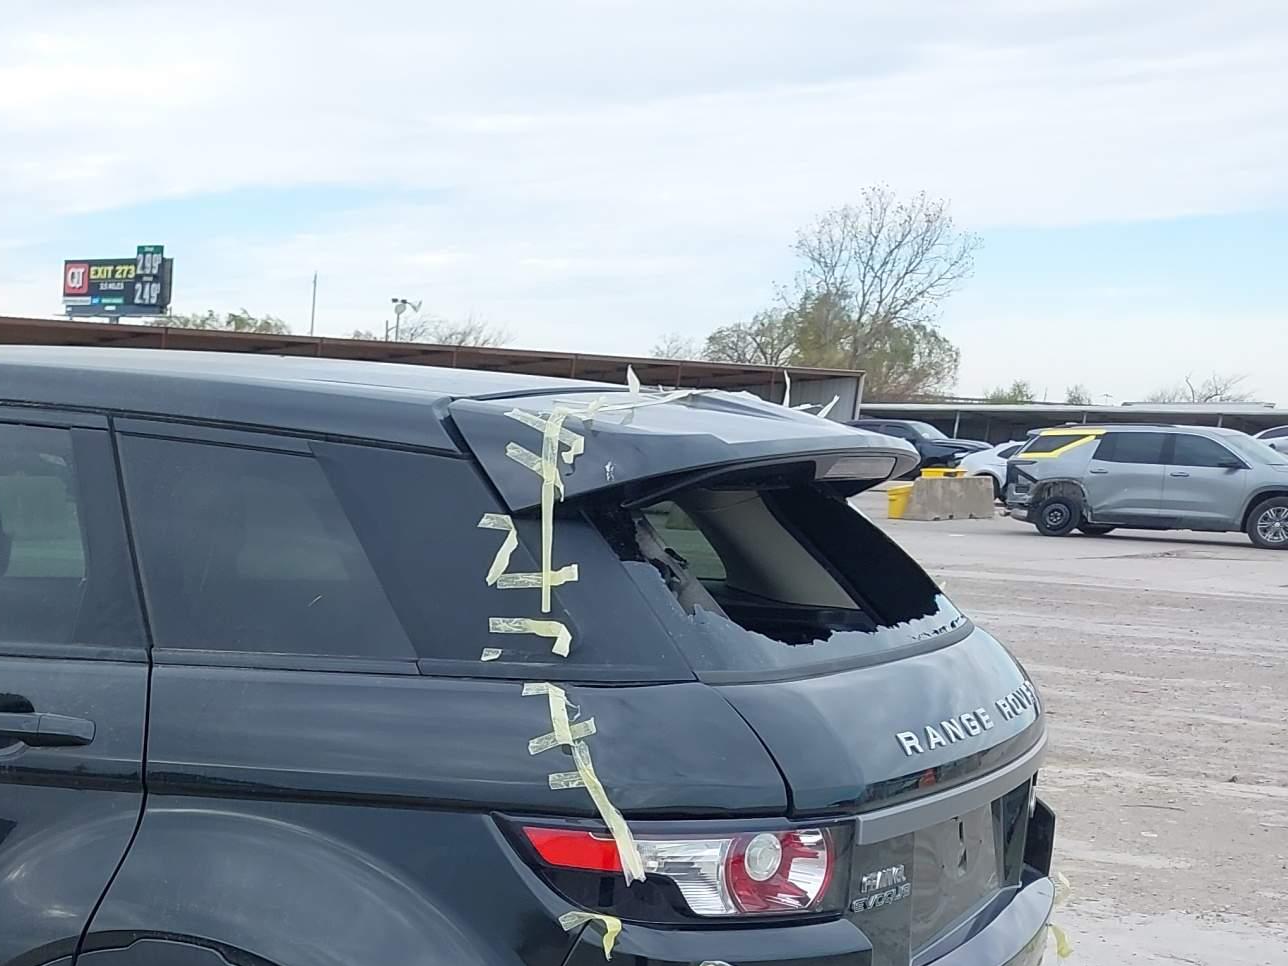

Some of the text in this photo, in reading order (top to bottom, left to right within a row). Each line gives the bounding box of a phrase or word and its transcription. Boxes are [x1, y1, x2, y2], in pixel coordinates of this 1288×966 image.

[90, 264, 136, 279] EXIT 273
[895, 707, 994, 756] RANGE
